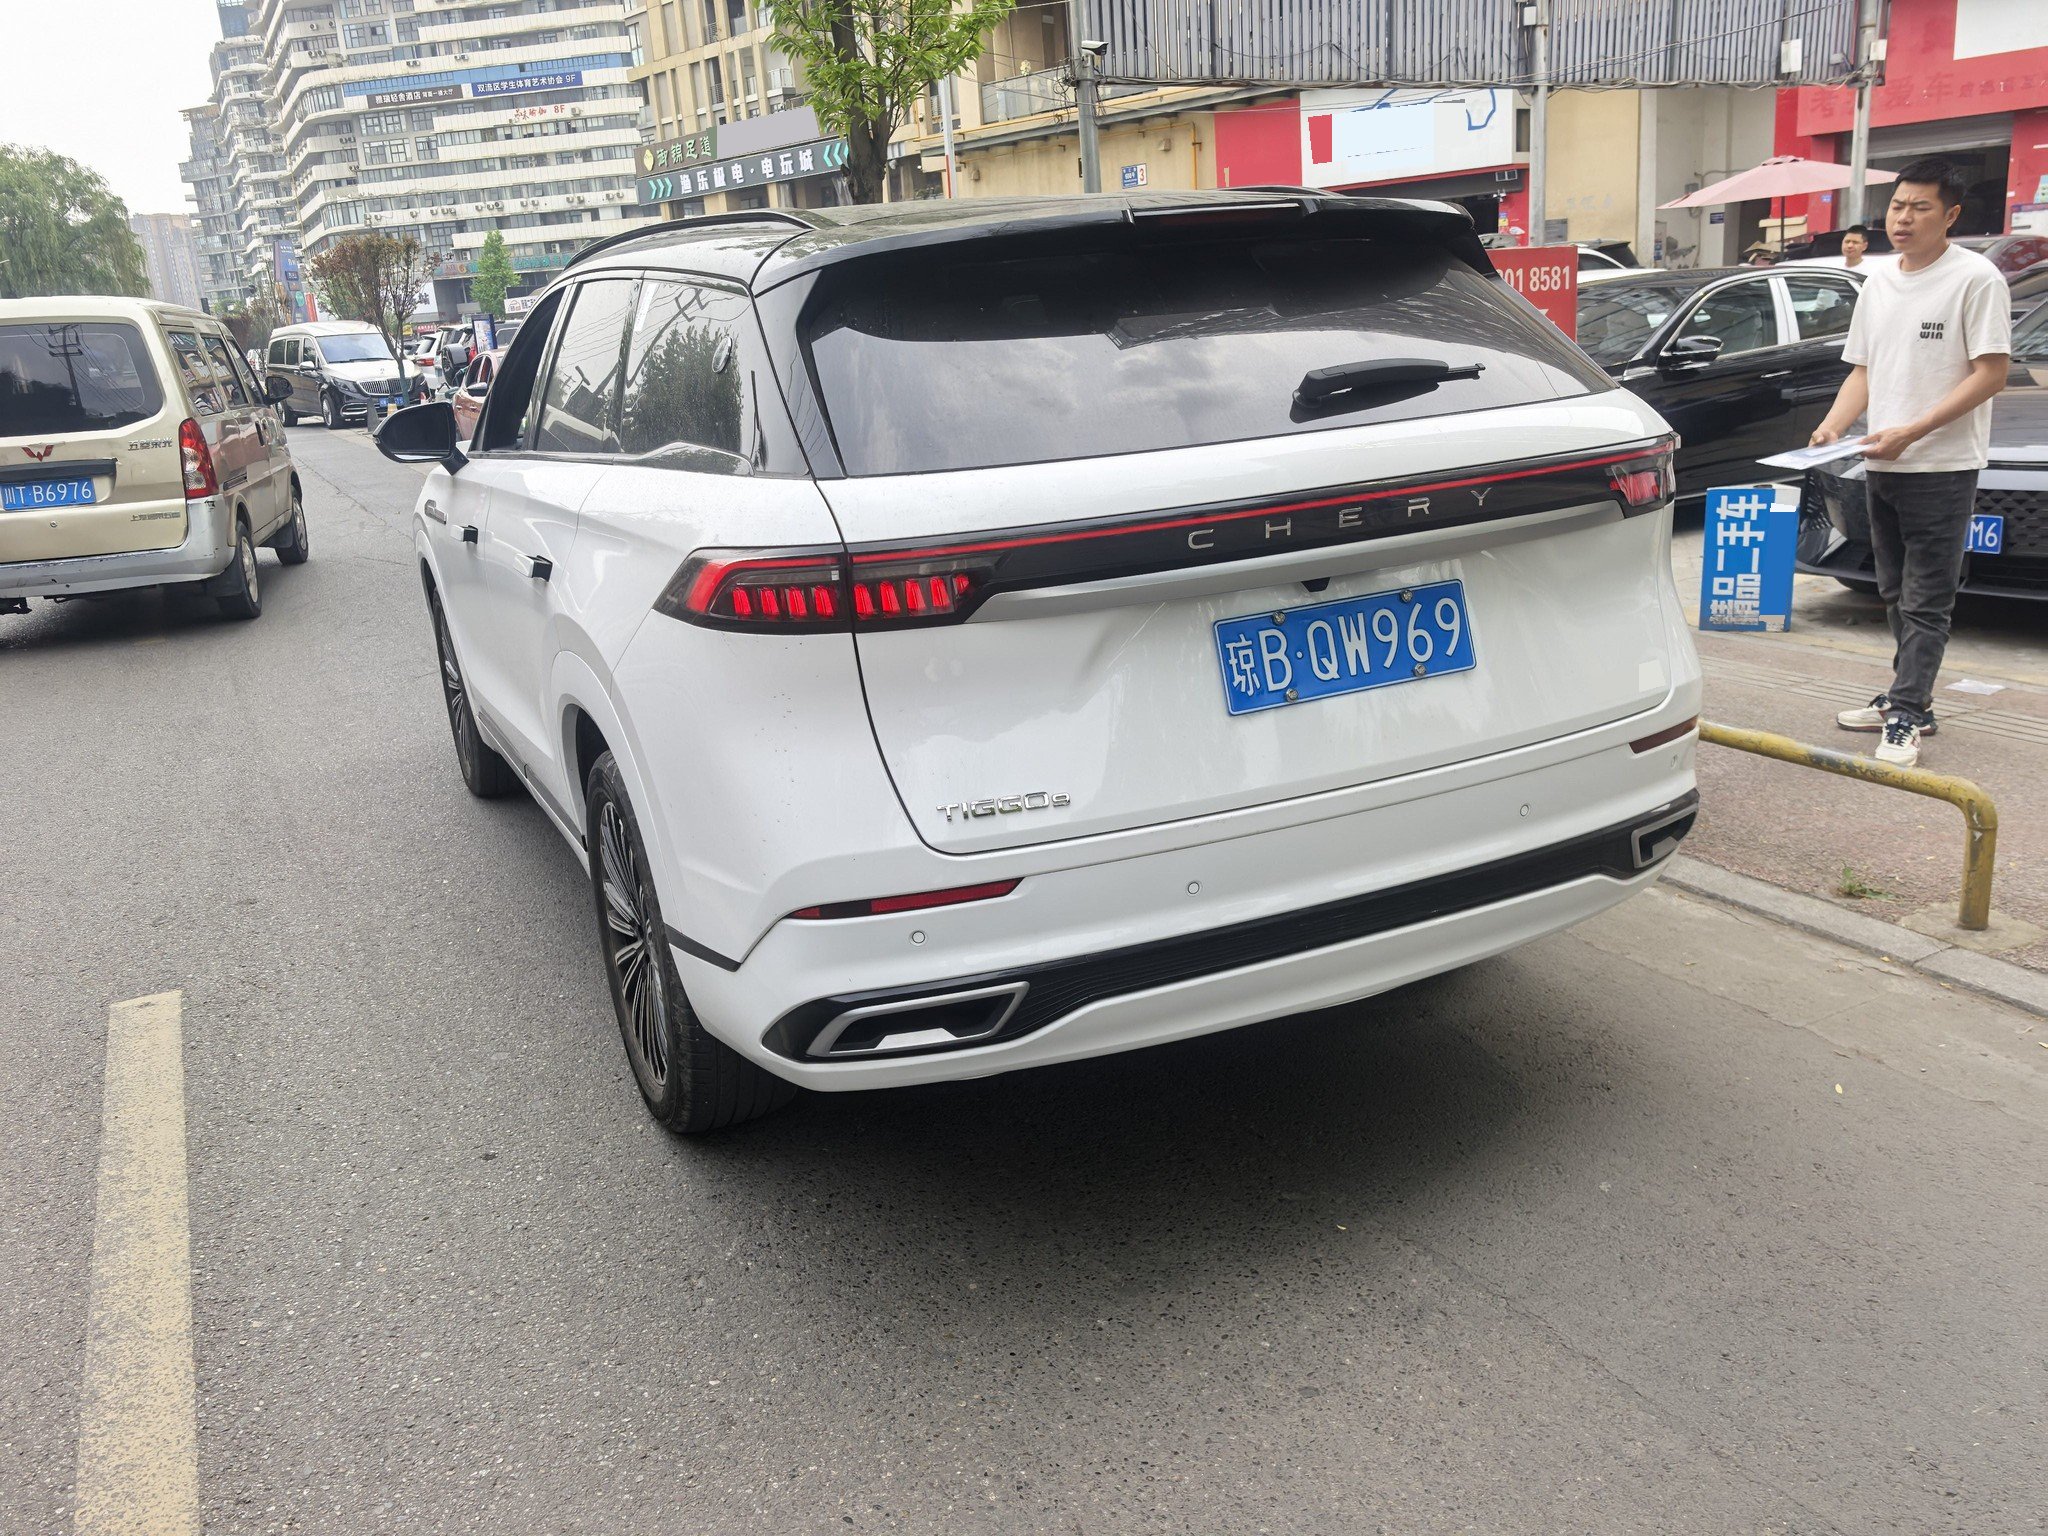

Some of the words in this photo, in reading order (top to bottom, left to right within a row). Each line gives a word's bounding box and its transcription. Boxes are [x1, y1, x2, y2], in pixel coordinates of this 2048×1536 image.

[477, 75, 564, 94] 双流区学生体育艺术协会
[565, 74, 576, 84] 9F
[554, 104, 566, 114] 8F
[1139, 168, 1145, 182] 3
[1529, 265, 1571, 292] 8581
[5, 481, 92, 505] 川T·B6976
[1187, 487, 1493, 551] CHERY
[1225, 597, 1461, 697] 琼B·QW969
